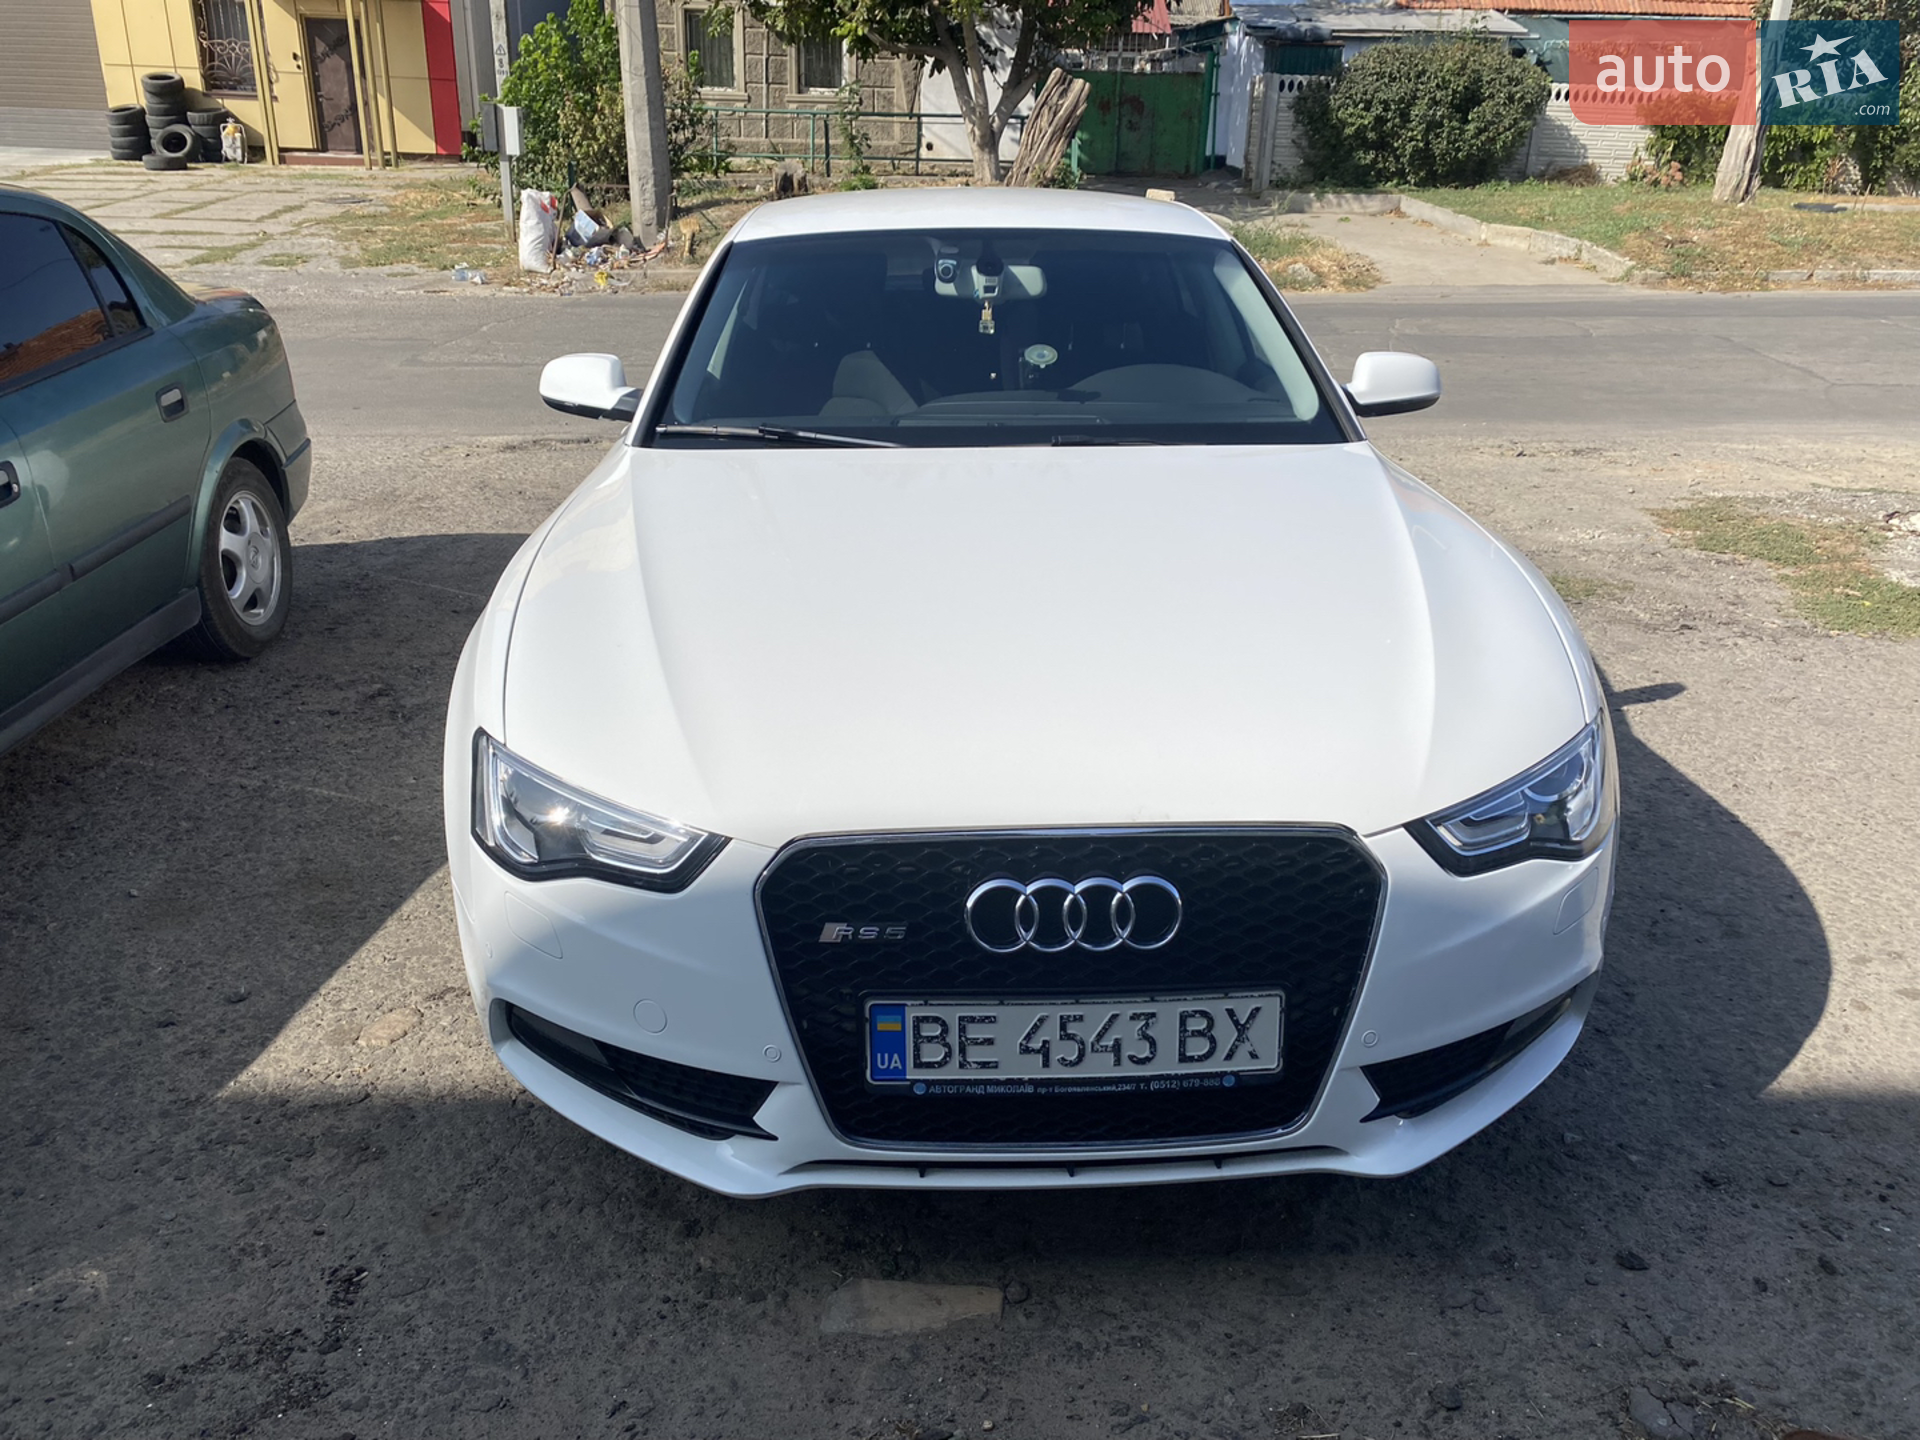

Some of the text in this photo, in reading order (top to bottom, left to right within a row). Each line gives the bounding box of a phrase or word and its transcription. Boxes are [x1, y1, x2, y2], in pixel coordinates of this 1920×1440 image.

[911, 1006, 1262, 1069] BE 4543 BX
[876, 1053, 902, 1070] UA
[928, 1084, 985, 1095] АВТОГРАНД
[986, 1082, 1034, 1093] МИКОЛАЇВ
[1150, 1079, 1180, 1091] (0512)
